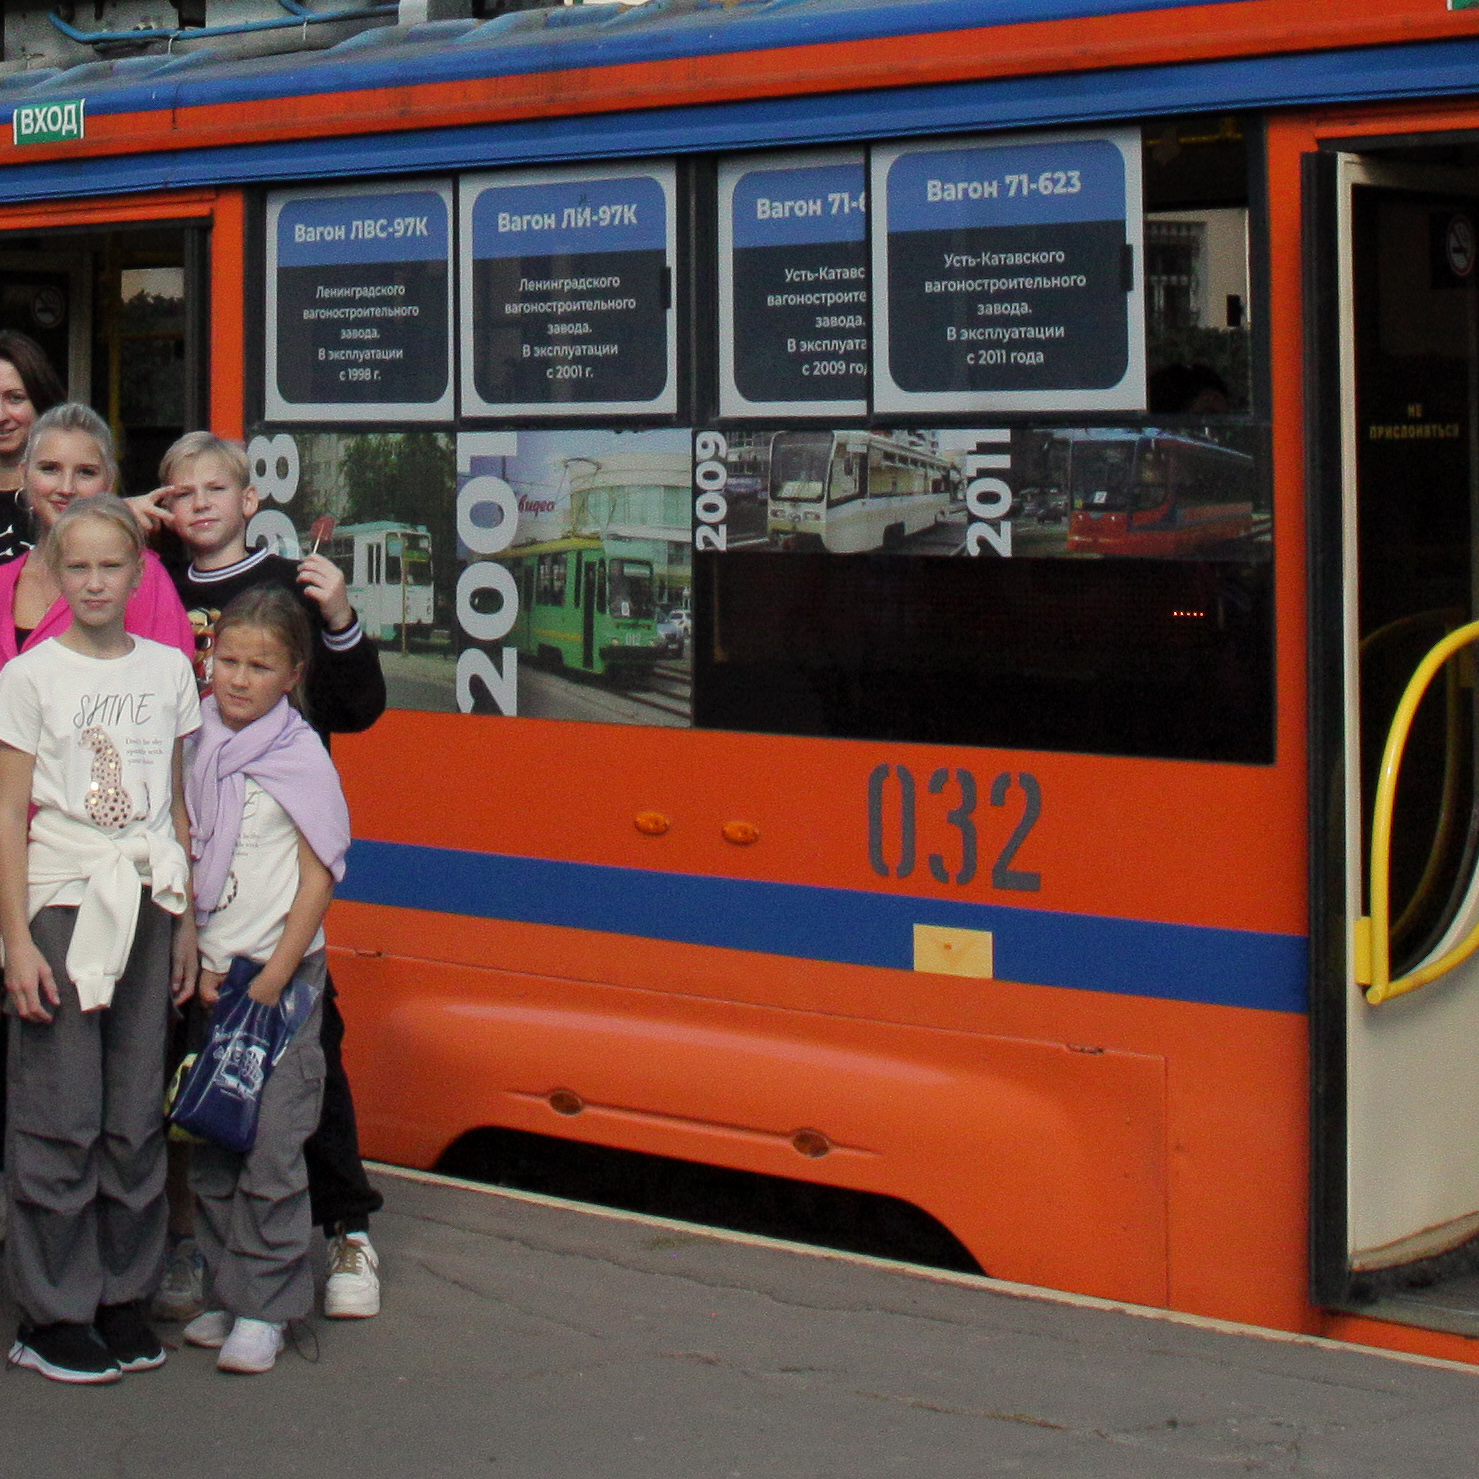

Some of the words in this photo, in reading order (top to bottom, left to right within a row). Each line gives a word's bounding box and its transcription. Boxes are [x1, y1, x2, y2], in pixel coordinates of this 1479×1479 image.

[21, 103, 78, 136] ВХОД
[927, 178, 1000, 202] Вагон
[1004, 170, 1082, 198] 71-623
[756, 198, 822, 219] Вагон
[497, 212, 556, 232] Вагон
[561, 204, 638, 229] ЛИ-97К
[294, 223, 346, 243] Вагон
[350, 216, 429, 240] ЛВС-97К
[944, 250, 1065, 269] Усть-Катавского
[316, 284, 406, 300] Ленинградского
[519, 276, 621, 293] Ленинградского
[924, 274, 1087, 294] вагоностроительного
[303, 305, 419, 320] вагоностроительного
[504, 297, 637, 315] вагоностроительного
[977, 302, 1032, 316] завода.
[547, 323, 593, 335] завода.
[815, 316, 866, 329] завода.
[340, 328, 381, 339] завода.
[946, 327, 957, 341] В
[959, 324, 1066, 343] эксплуатации
[522, 344, 531, 358] В
[533, 344, 619, 360] эксплуатации
[787, 338, 796, 352] В
[318, 348, 326, 361] В
[328, 347, 404, 362] эксплуатации
[966, 352, 975, 365] с
[978, 350, 1006, 365] 2011
[1010, 351, 1045, 365] года
[339, 369, 346, 381] с
[348, 368, 372, 381] 1998
[374, 369, 382, 380] г.
[546, 367, 554, 379] с
[555, 366, 582, 379] 2001
[585, 366, 595, 378] г.
[801, 364, 810, 376] с
[812, 361, 846, 376] 2009
[1369, 423, 1460, 440] ПРИСЛОНЯТЬСЯ
[695, 430, 727, 551] 2009
[966, 429, 1013, 557] 2011
[456, 431, 519, 716] 2001
[73, 693, 155, 729] SHINE
[868, 763, 1042, 892] 032
